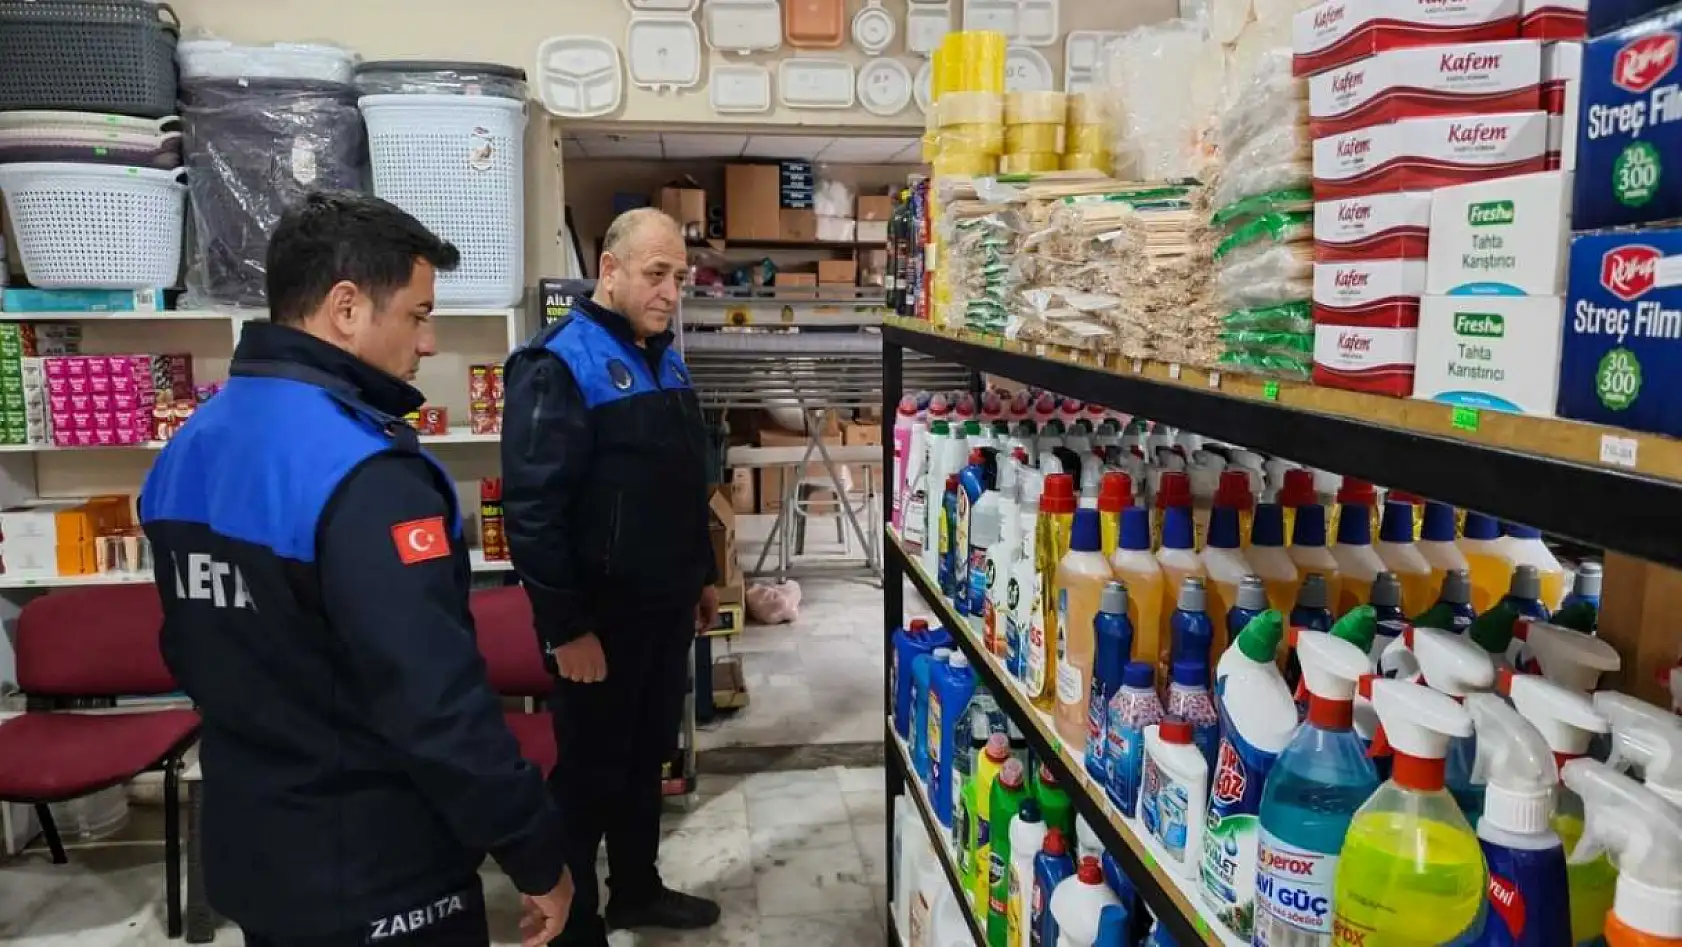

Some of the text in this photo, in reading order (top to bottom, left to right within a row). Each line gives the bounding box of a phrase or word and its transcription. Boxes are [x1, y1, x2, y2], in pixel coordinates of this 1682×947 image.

[1440, 51, 1503, 73] Kafem
[1331, 71, 1364, 92] Kafem
[1588, 101, 1645, 139] Streç
[1448, 123, 1509, 145] Kafem
[1337, 137, 1371, 157] Kafem
[1618, 165, 1656, 190] 300
[1338, 202, 1371, 222] Kafem
[1472, 234, 1503, 249] Tahta
[1335, 269, 1369, 288] Kafem
[1574, 300, 1682, 343] Streç Film
[1337, 332, 1372, 351] Kafem
[1458, 344, 1491, 360] Tahta
[1608, 352, 1628, 371] 30
[1601, 370, 1636, 394] 300
[1490, 875, 1515, 906] YENİ
[1278, 889, 1328, 917] GÜÇ
[371, 896, 462, 939] ZABITA
